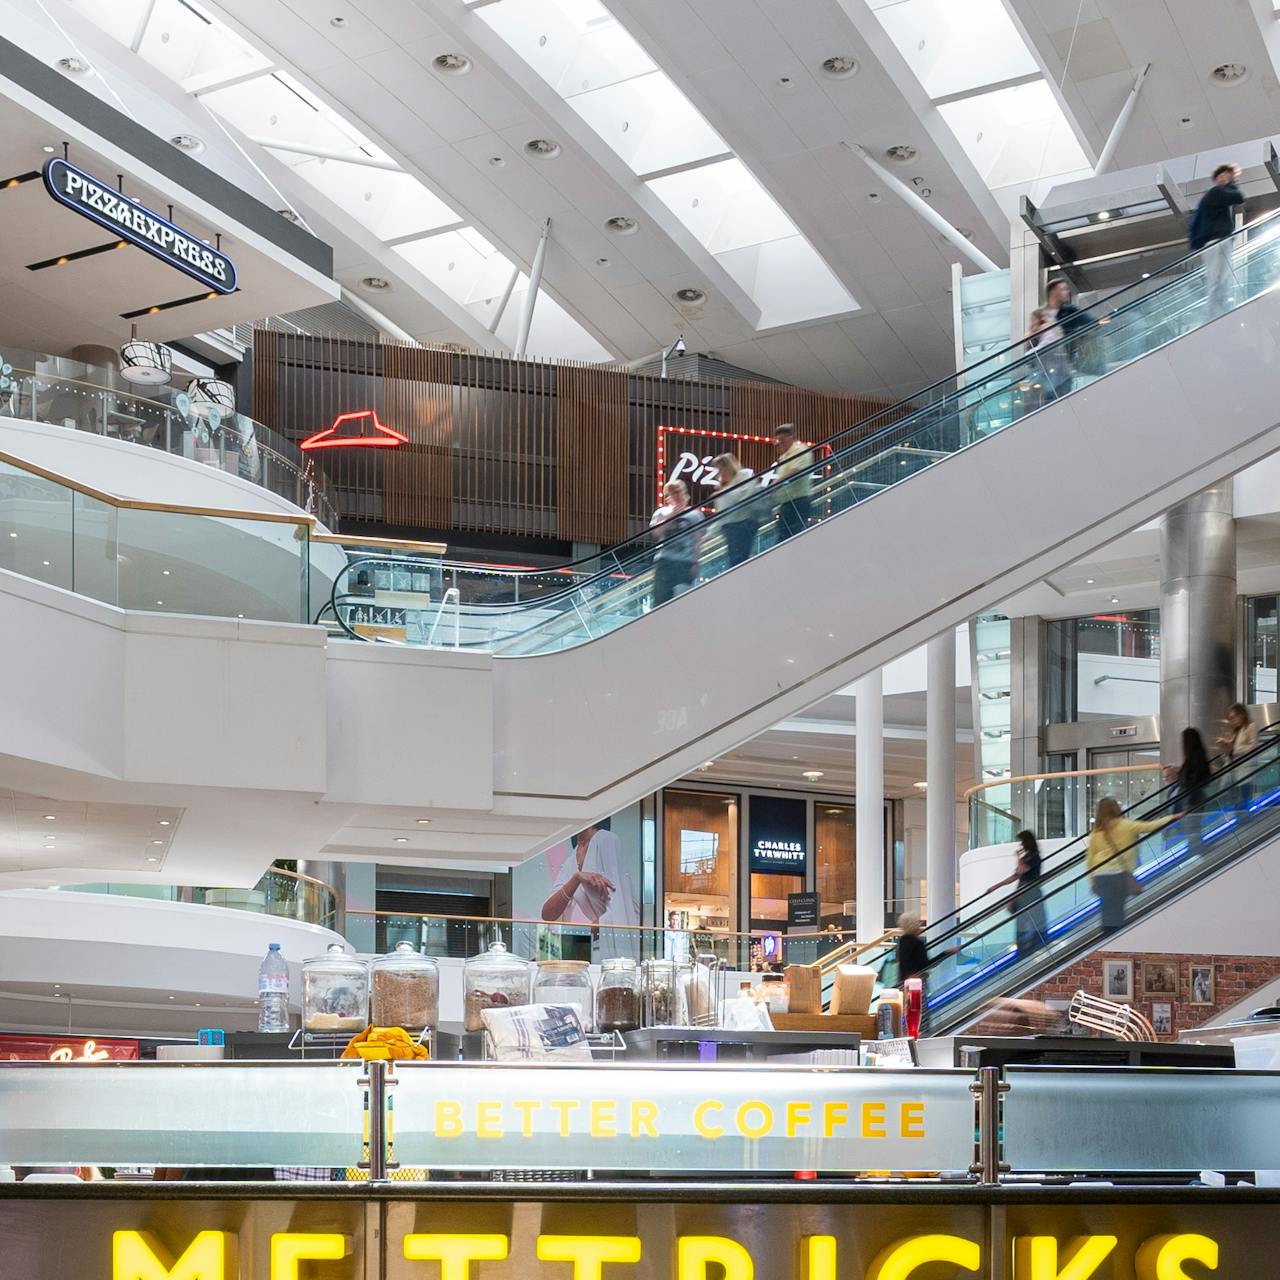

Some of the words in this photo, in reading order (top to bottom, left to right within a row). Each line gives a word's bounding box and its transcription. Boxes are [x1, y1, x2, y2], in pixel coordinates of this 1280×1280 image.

[65, 170, 226, 281] PIZZAEXPRESS
[754, 849, 805, 860] TYRWHITT
[757, 841, 801, 851] CHARLES
[433, 1098, 660, 1140] BETTER
[693, 1099, 926, 1140] COFFEE
